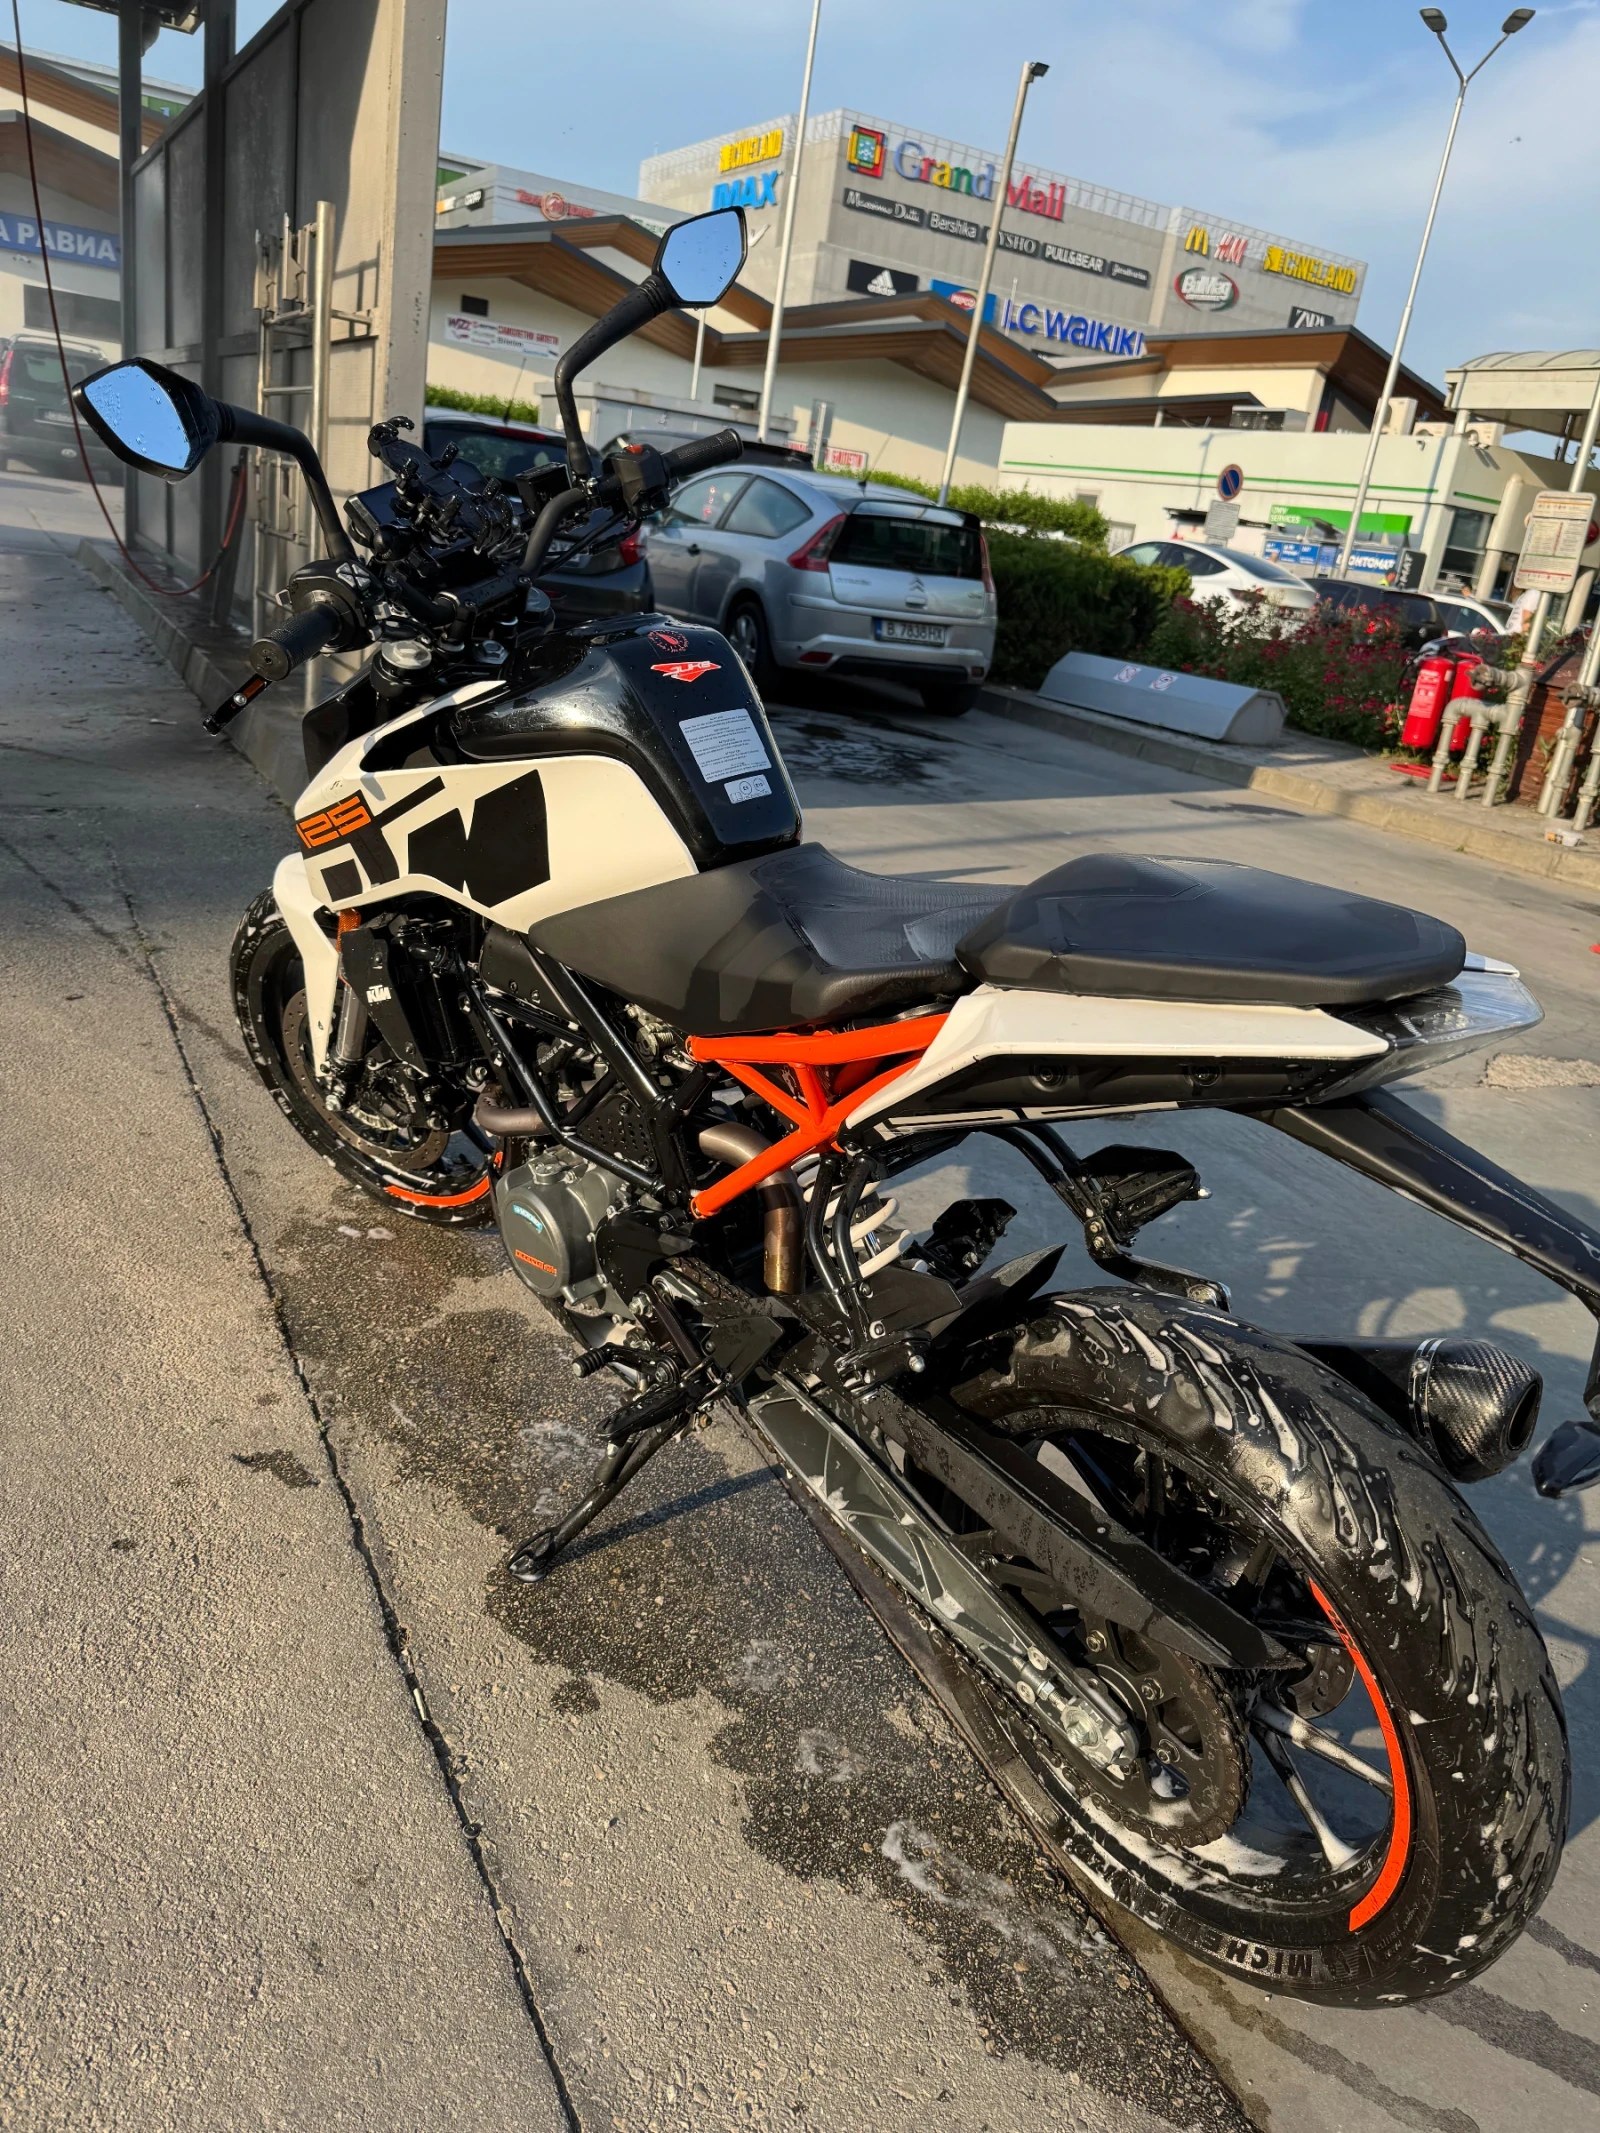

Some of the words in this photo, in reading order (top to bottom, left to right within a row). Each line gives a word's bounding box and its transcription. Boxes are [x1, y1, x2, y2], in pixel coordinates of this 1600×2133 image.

[711, 169, 777, 212] IMAX
[894, 141, 995, 199] Grand
[1005, 174, 1066, 221] Mall
[930, 213, 977, 238] Bershka
[1045, 245, 1103, 273] PULL&BEAR
[1283, 251, 1356, 294] CINELAND
[1001, 298, 1039, 335] LC
[296, 795, 371, 849] 125
[366, 984, 392, 1003] KTM
